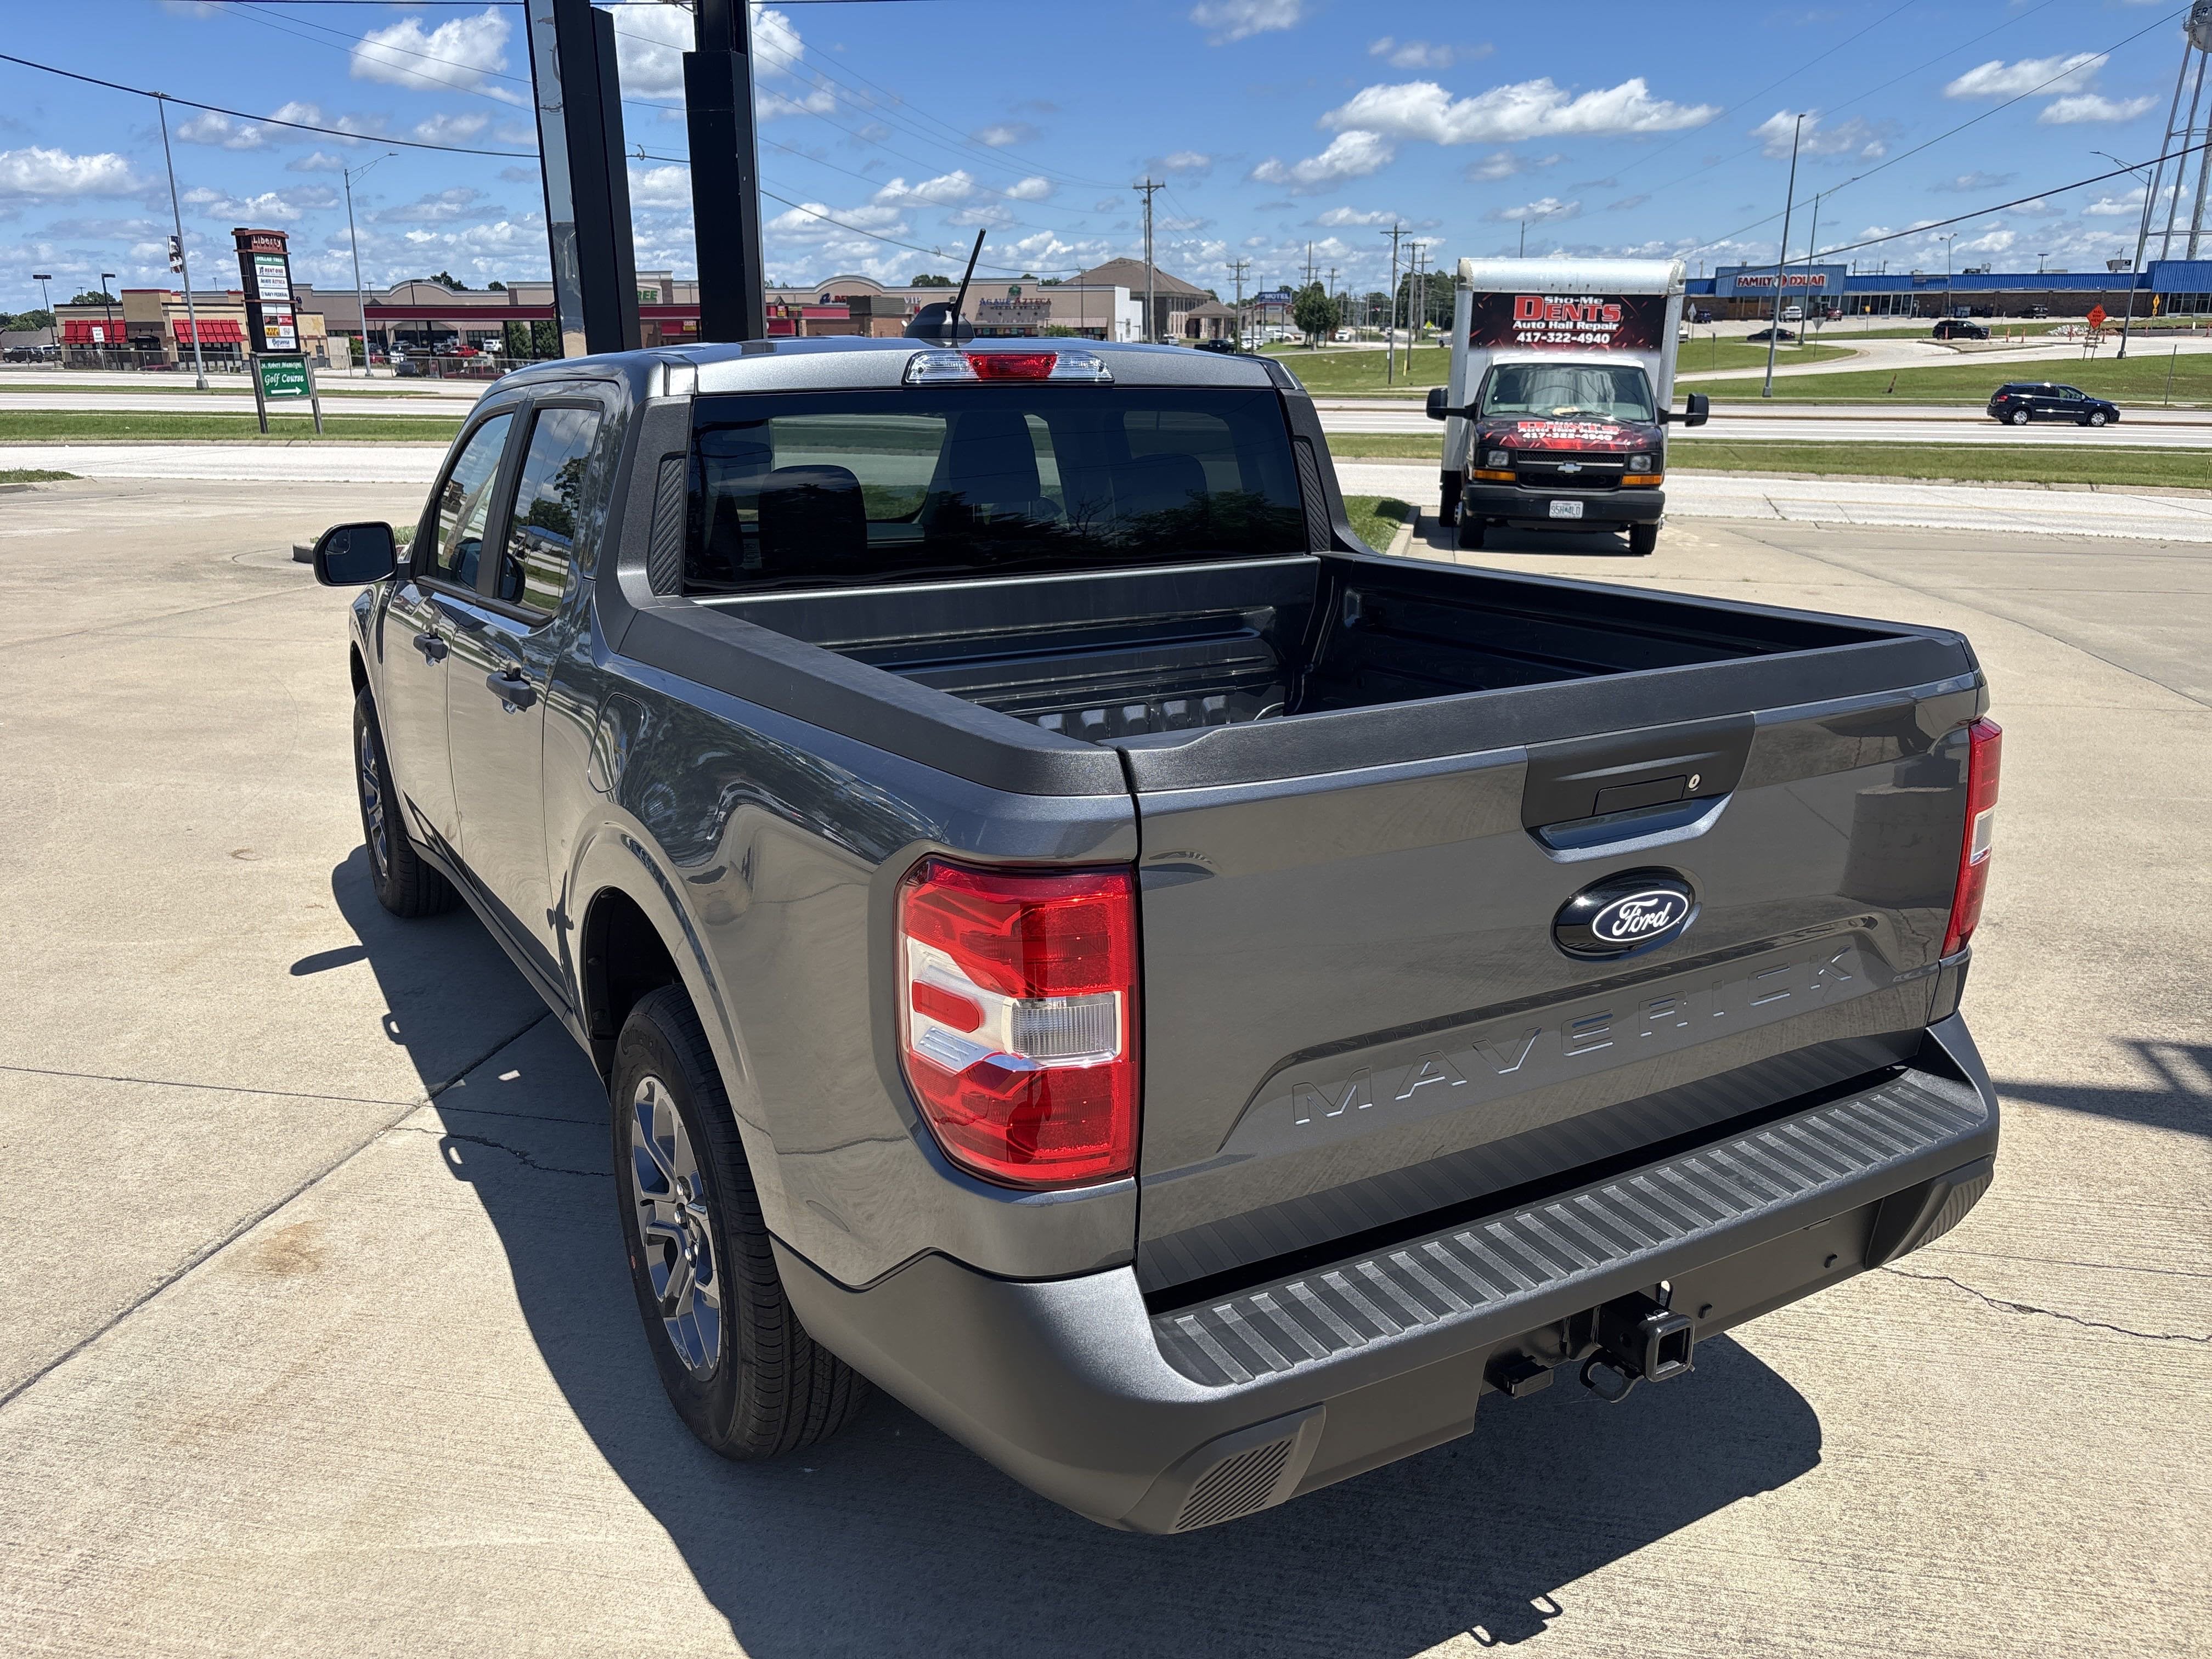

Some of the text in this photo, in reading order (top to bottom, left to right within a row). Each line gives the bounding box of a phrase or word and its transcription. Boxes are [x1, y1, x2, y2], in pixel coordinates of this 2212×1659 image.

[253, 235, 281, 247] Liberty
[1737, 275, 1825, 286] FAMILY DOLAR
[637, 291, 657, 300] REE
[1544, 296, 1604, 304] Sho-Me
[1513, 296, 1621, 322] DENTS
[1513, 321, 1619, 332] Auto Hail Repair
[1516, 331, 1610, 343] 417-322-4940
[264, 373, 304, 386] Golf Course
[1612, 898, 1672, 936] Ford
[1293, 945, 1853, 1125] MAVERICK
